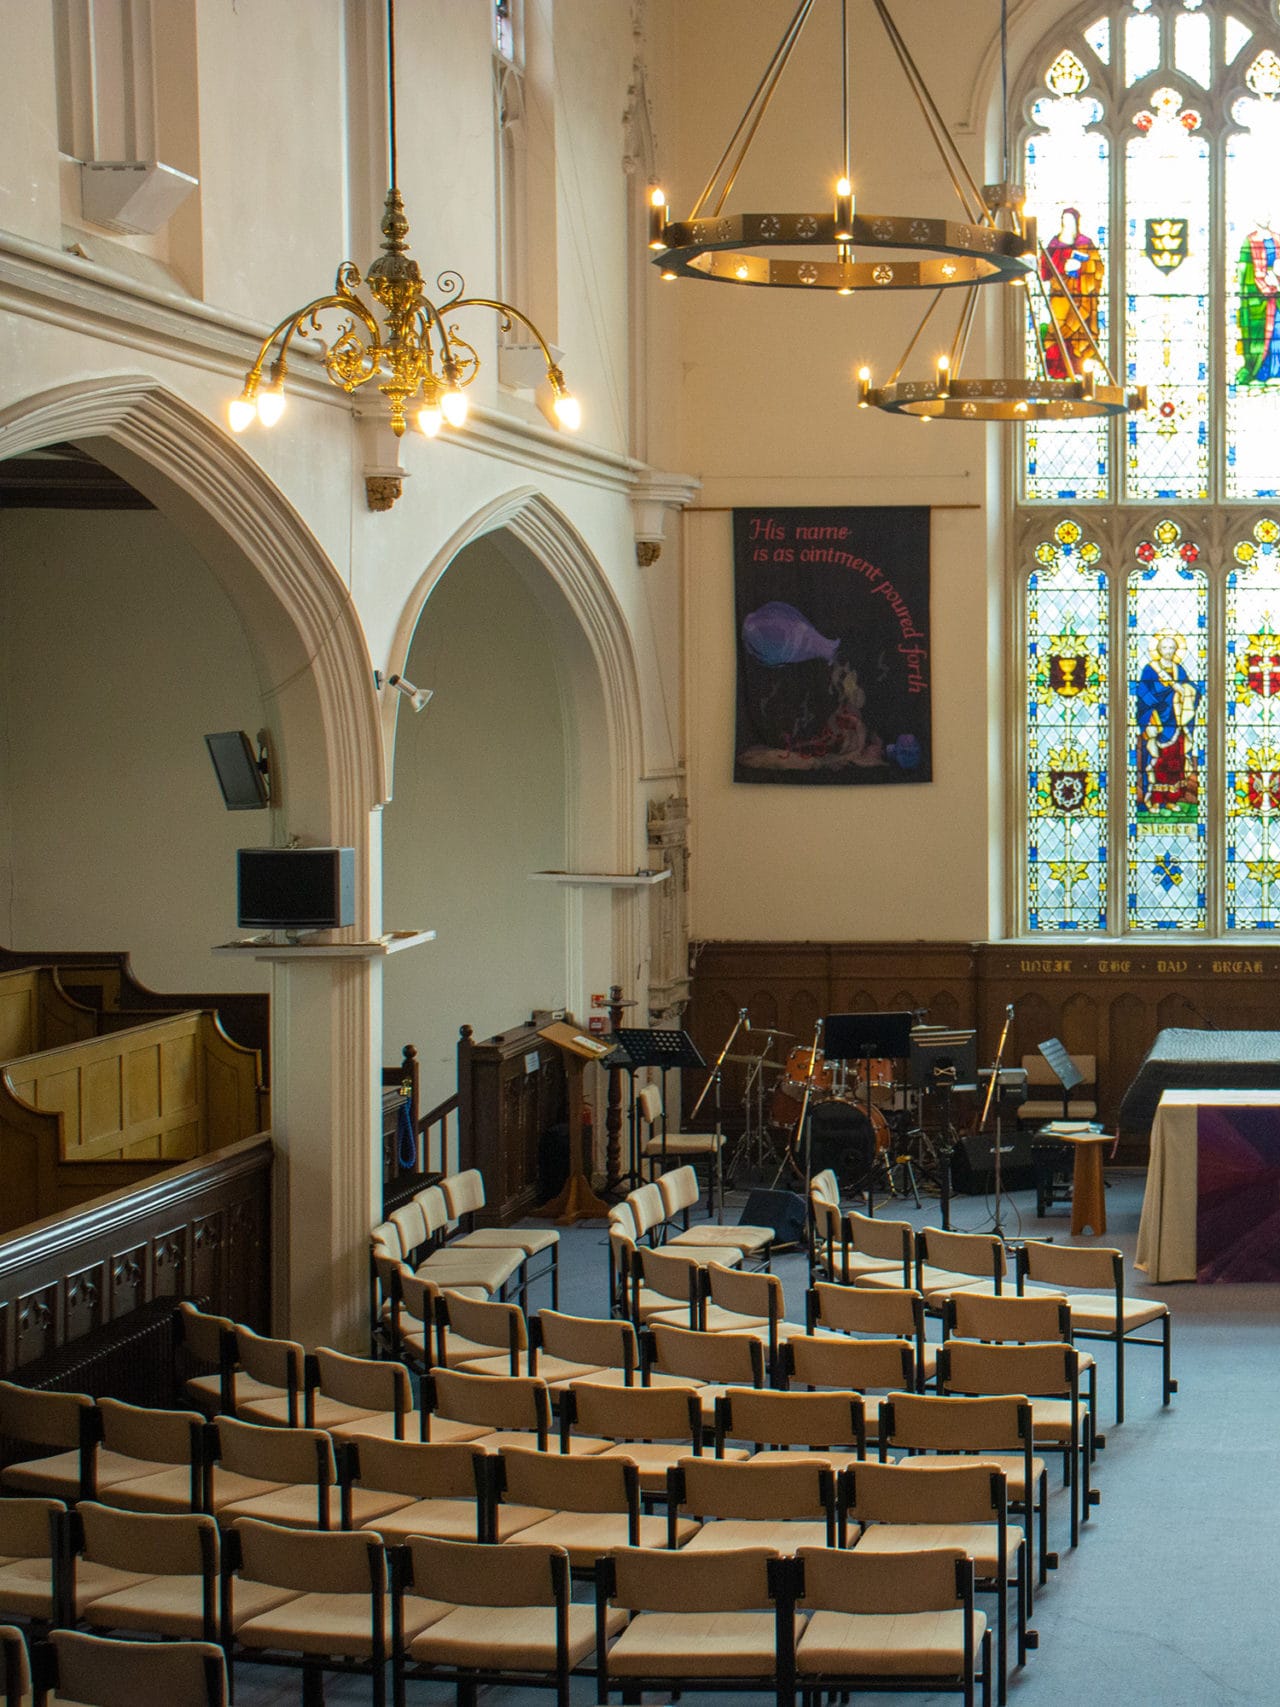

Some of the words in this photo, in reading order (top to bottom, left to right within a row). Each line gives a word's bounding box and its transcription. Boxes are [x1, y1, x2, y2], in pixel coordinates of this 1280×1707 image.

[750, 518, 785, 540] His
[795, 526, 853, 540] name
[753, 546, 769, 561] is
[773, 547, 795, 562] as
[800, 545, 884, 582] ointment
[871, 580, 925, 639] poured
[898, 644, 928, 693] forth
[1098, 960, 1132, 973] THE
[1157, 960, 1188, 973] DAY
[1212, 961, 1263, 973] BREAK
